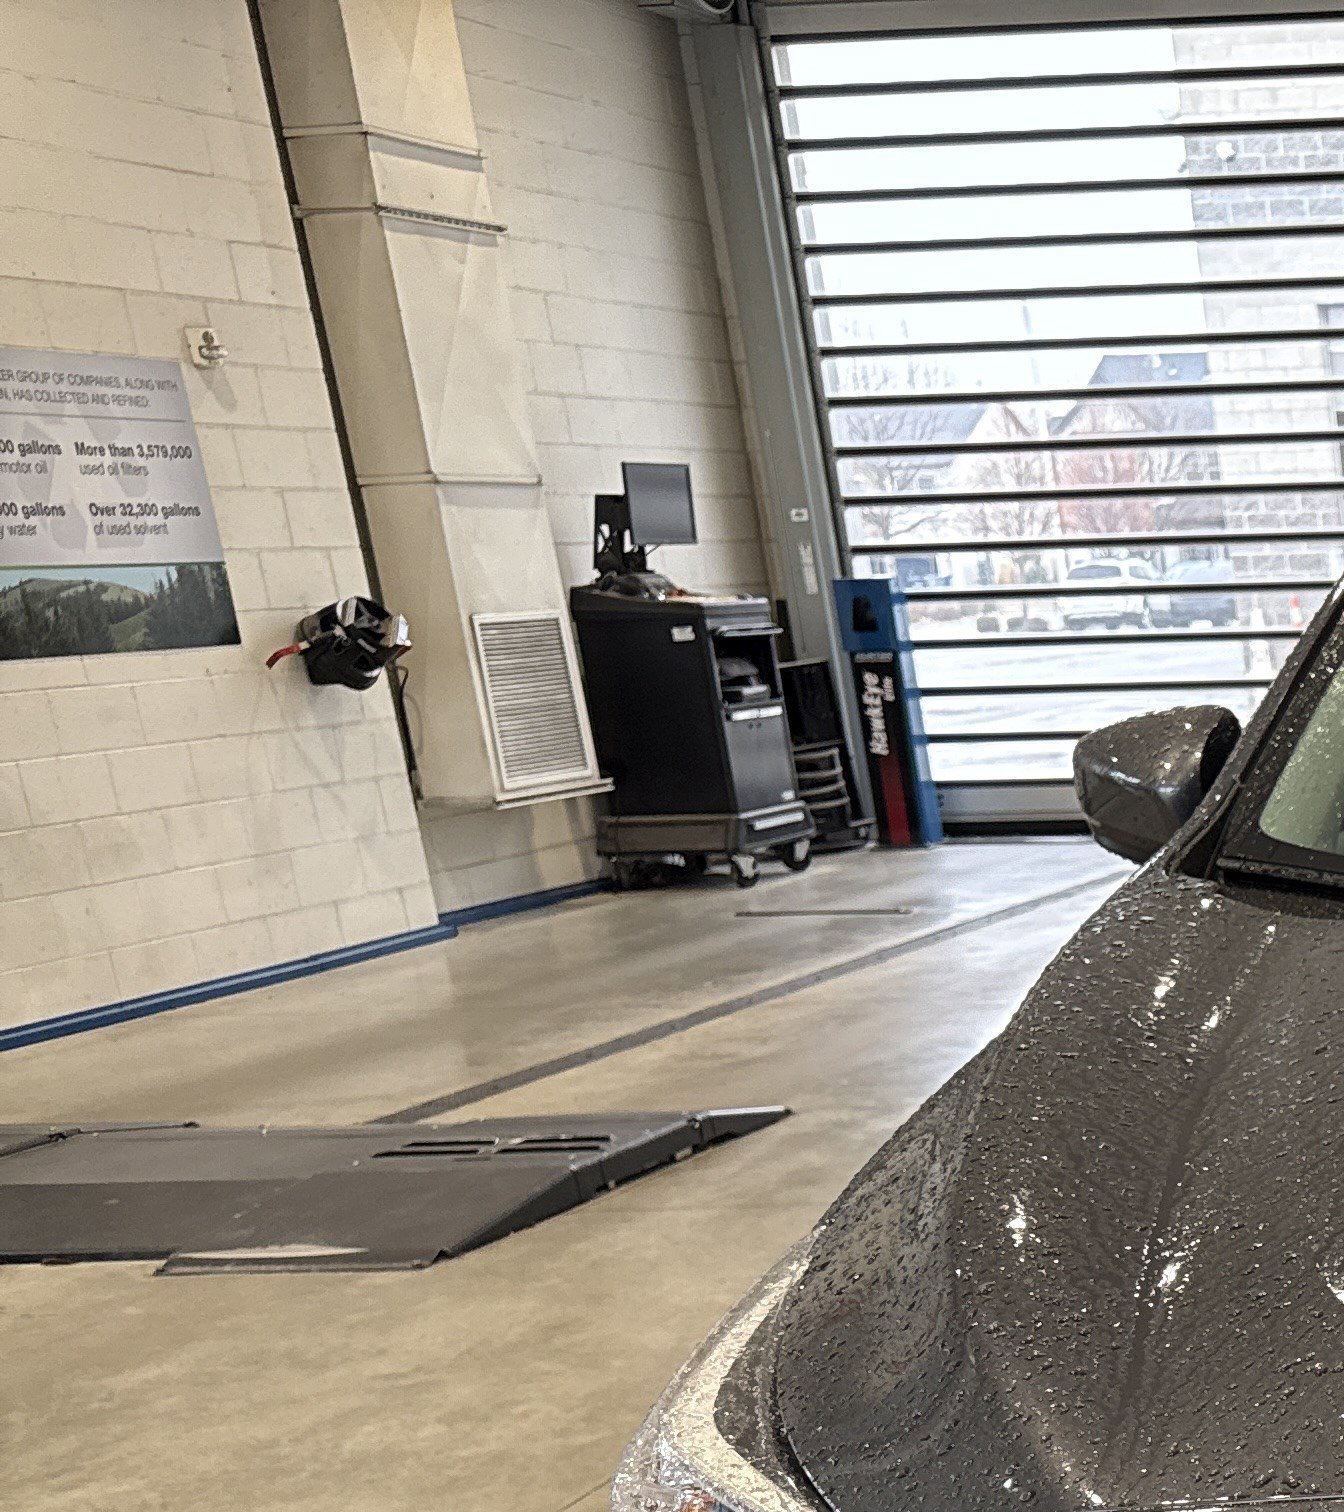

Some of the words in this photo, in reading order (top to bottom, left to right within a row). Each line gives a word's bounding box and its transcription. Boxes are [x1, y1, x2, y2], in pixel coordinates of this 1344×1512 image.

[0, 368, 15, 381] ER
[16, 369, 50, 384] GROUP
[18, 440, 62, 457] gallons
[74, 441, 106, 457] More
[108, 443, 135, 457] than
[79, 462, 105, 475] used
[21, 502, 65, 519] gallons
[89, 502, 116, 517] Over
[161, 502, 201, 520] gallons
[7, 523, 37, 536] water
[94, 521, 104, 535] of
[106, 521, 131, 535] used
[134, 521, 168, 535] solvent
